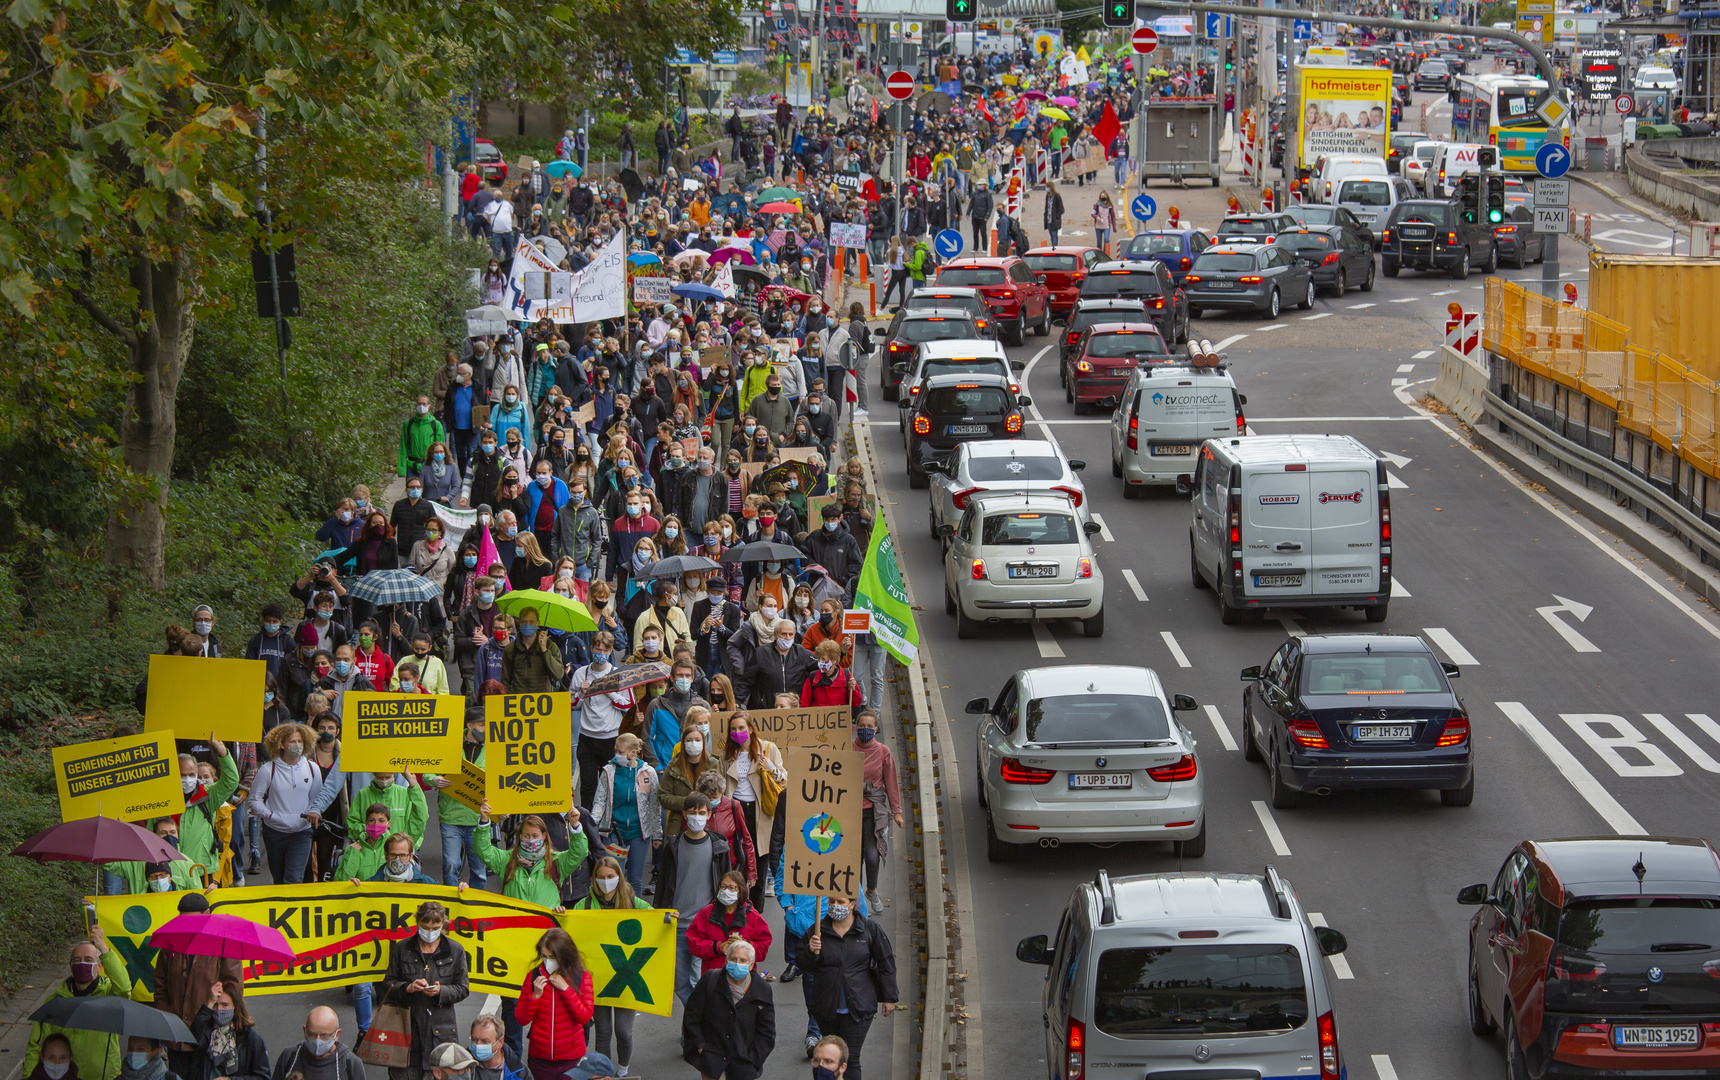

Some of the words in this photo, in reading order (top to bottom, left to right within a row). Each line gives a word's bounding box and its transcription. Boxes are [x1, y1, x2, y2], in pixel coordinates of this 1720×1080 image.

[779, 20, 786, 28] U
[1311, 80, 1382, 91] hofmeister
[1512, 103, 1524, 114] FOM
[1618, 100, 1630, 109] 40
[1538, 212, 1564, 222] TAXI
[830, 236, 845, 246] WIR
[604, 252, 620, 268] EIS
[574, 289, 604, 303] freund
[1165, 394, 1218, 404] tv.connect
[1320, 492, 1362, 504] SERVICE
[875, 611, 903, 636] streiken,
[361, 702, 398, 716] RAUS
[402, 701, 430, 715] AUS
[504, 694, 553, 717] ECO
[361, 723, 389, 736] DER
[393, 721, 443, 735] KOHLE!
[720, 710, 848, 734] IANDSFLÜGE
[490, 718, 540, 743] NOT
[1360, 728, 1372, 736] GP
[1379, 728, 1390, 736] IH
[1392, 727, 1410, 736] 371
[68, 751, 131, 775] GEMEINSAM
[134, 746, 154, 760] FÜR
[506, 742, 556, 766] EGO
[389, 757, 443, 766] GREENPEACE
[809, 753, 842, 776] Die
[71, 775, 114, 794] UNSERE
[116, 762, 166, 784] ZUKUNFT!
[463, 780, 480, 791] ACT
[802, 779, 848, 805] Uhr
[125, 800, 171, 814] GREENPEACE
[790, 860, 854, 896] tickt
[1624, 1030, 1639, 1042] WN
[1648, 1030, 1662, 1042] DS
[1666, 1029, 1695, 1042] 1952
